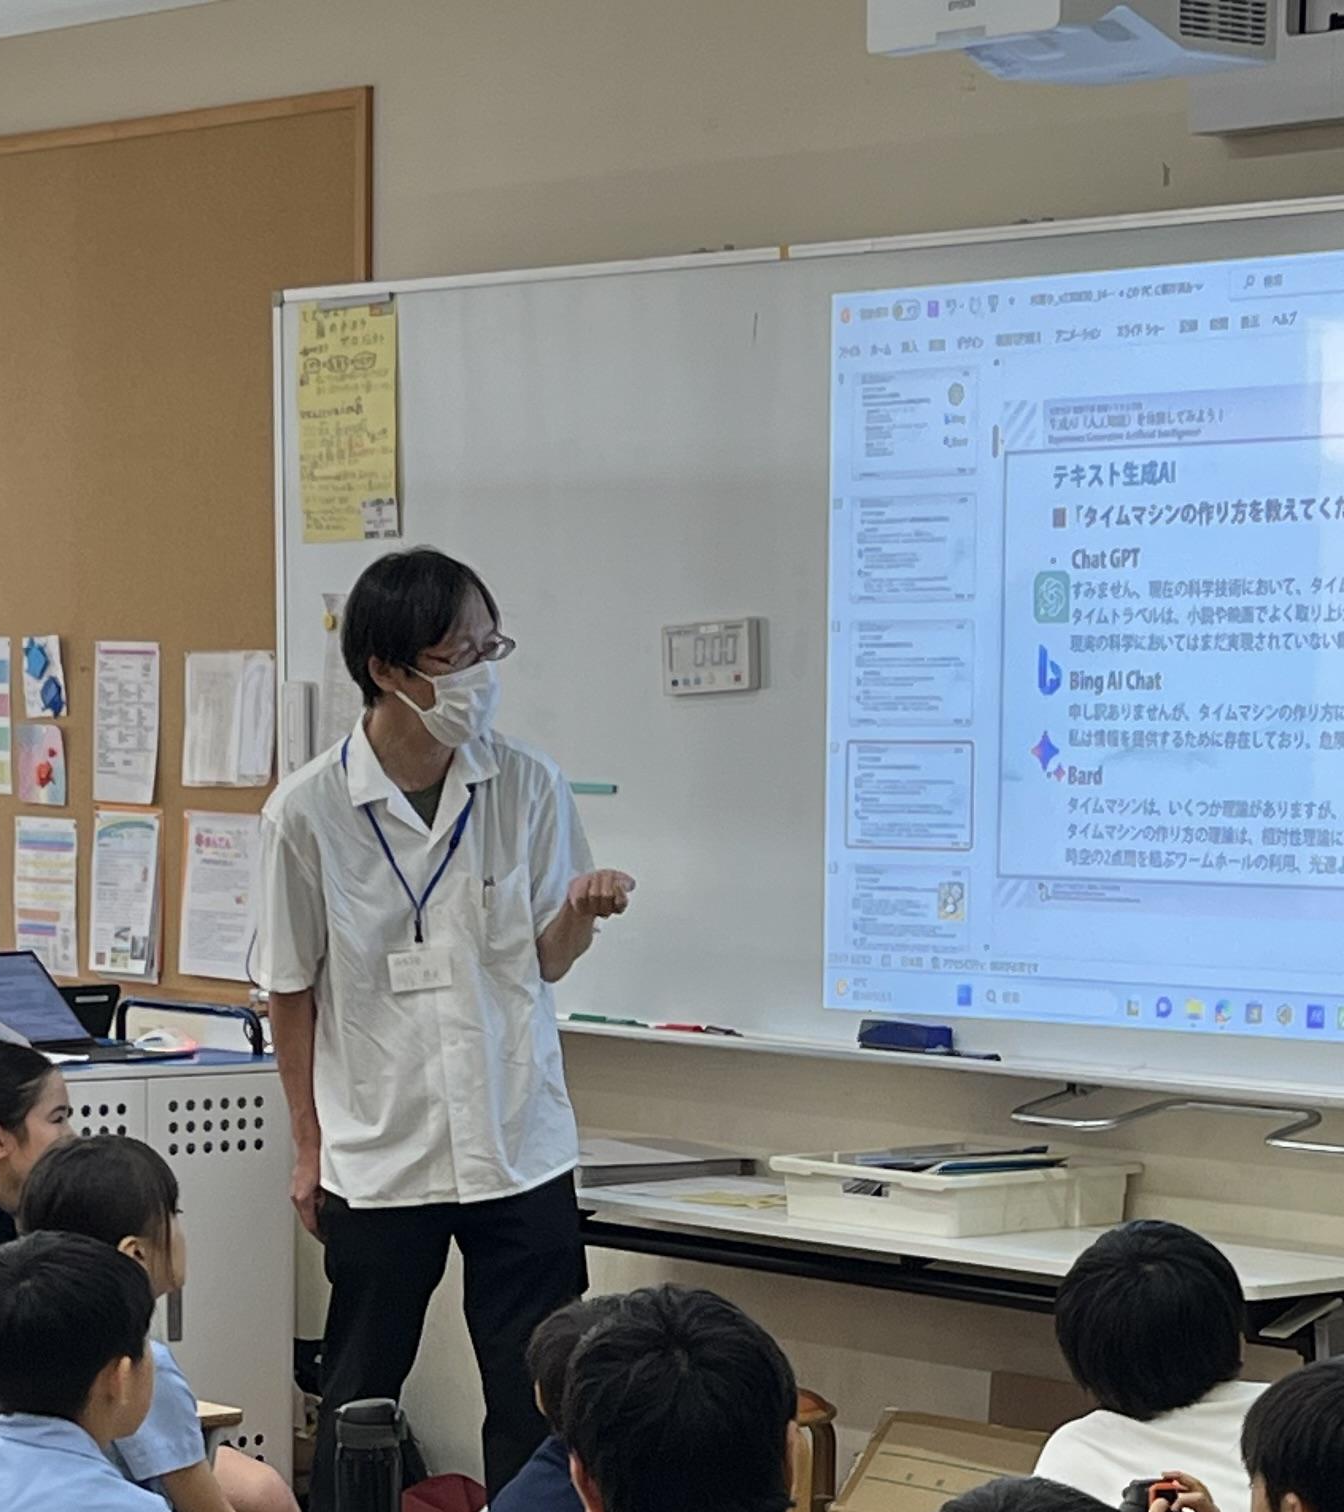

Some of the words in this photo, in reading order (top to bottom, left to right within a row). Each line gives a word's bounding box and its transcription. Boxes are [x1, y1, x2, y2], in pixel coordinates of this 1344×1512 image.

[1052, 460, 1177, 489] テキスト生成AI
[1071, 549, 1106, 569] Chat
[1109, 548, 1141, 568] GPT
[1069, 670, 1104, 695] Bing
[1106, 670, 1123, 690] AI
[1125, 670, 1162, 691] Chat
[1067, 765, 1104, 786] Bard
